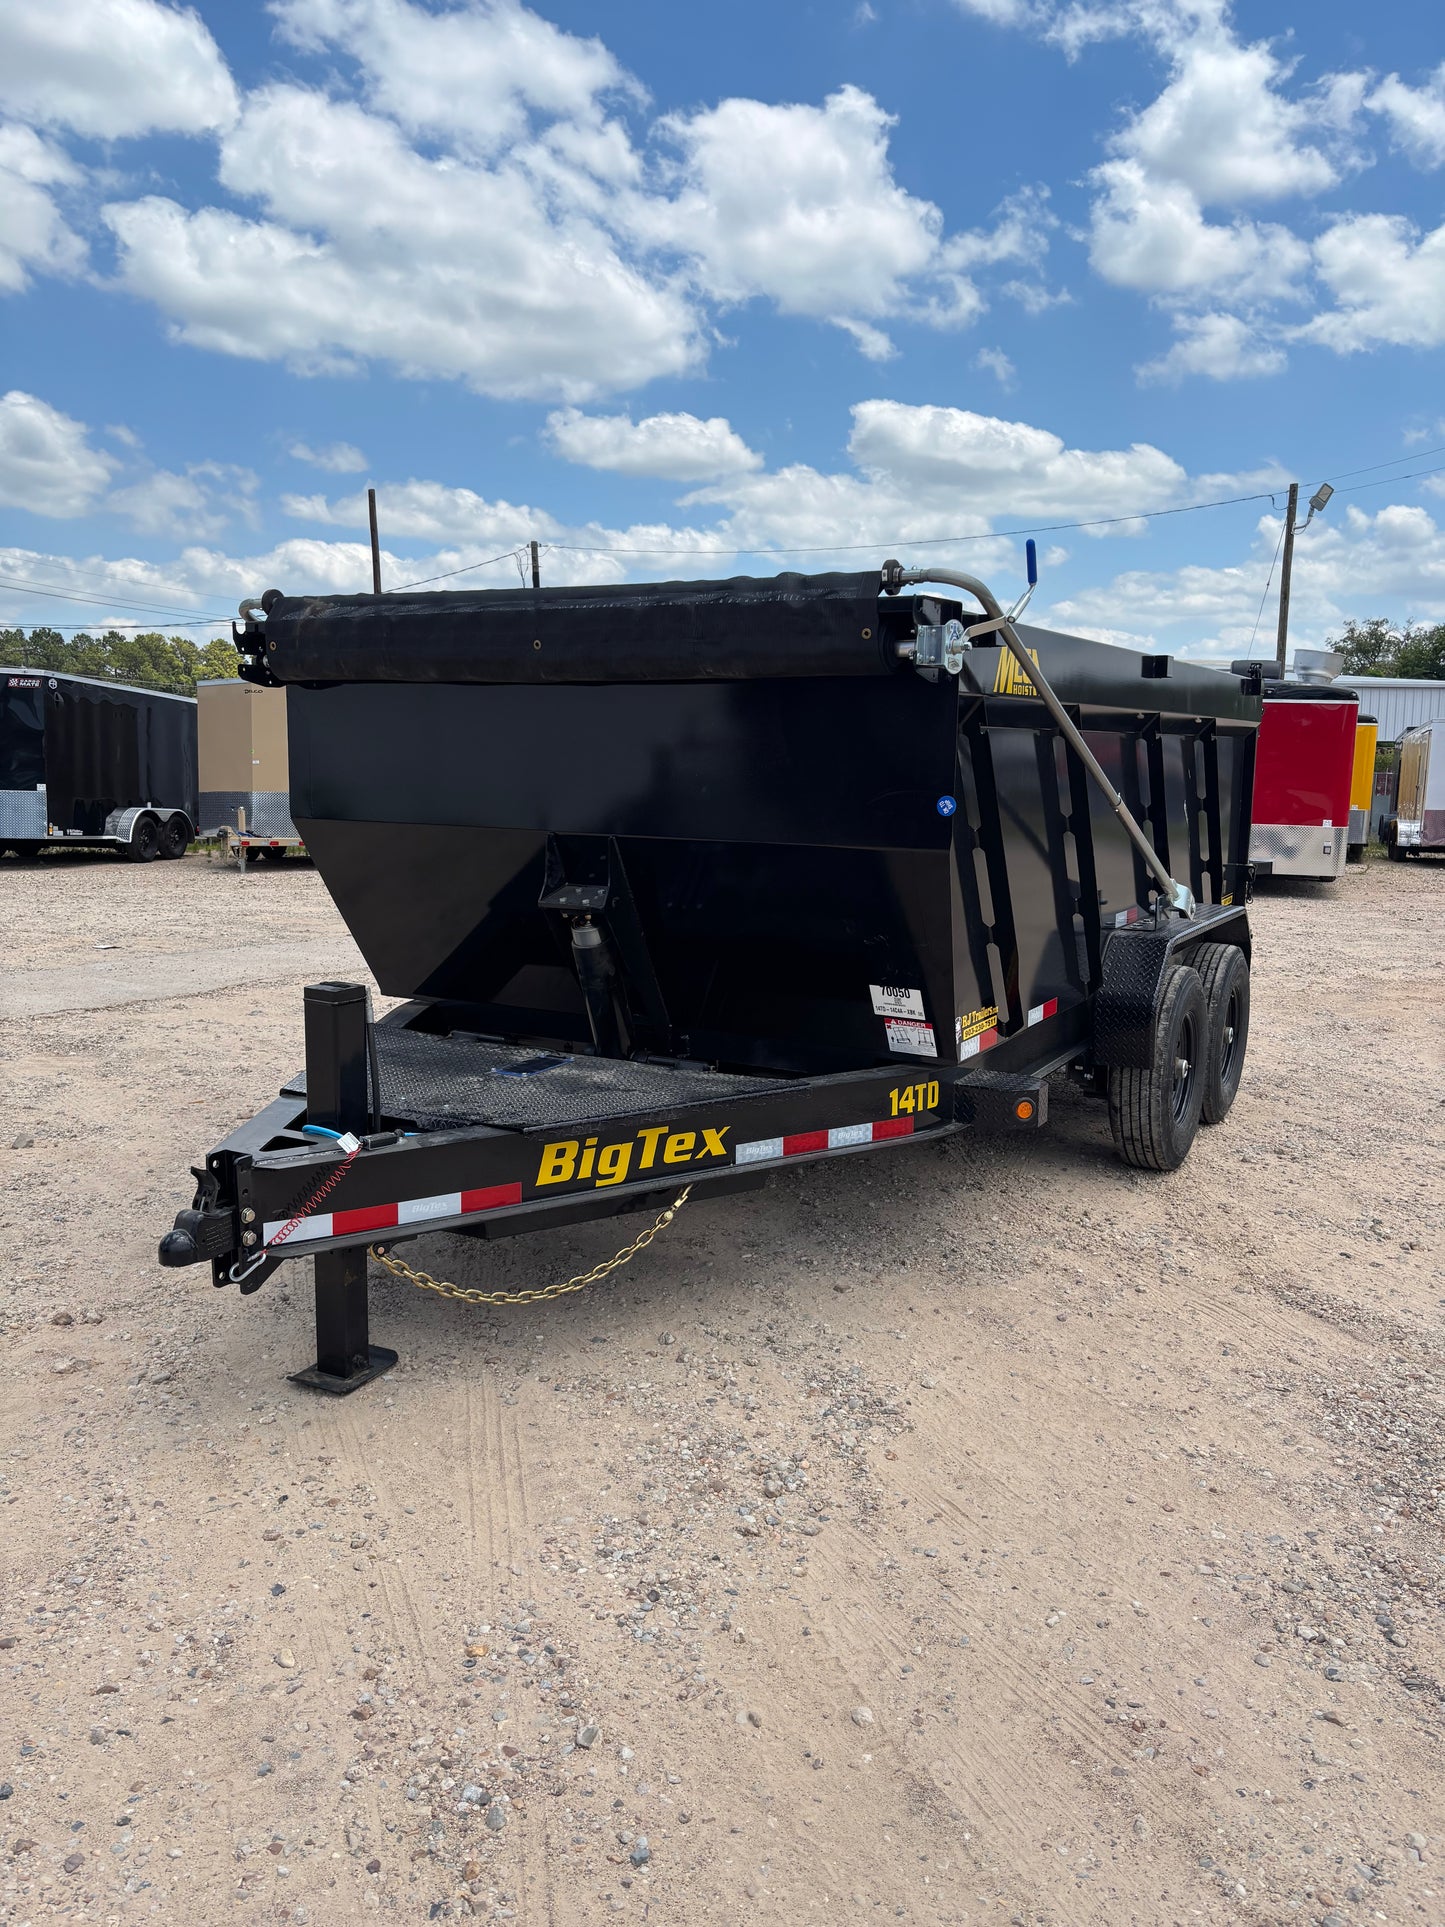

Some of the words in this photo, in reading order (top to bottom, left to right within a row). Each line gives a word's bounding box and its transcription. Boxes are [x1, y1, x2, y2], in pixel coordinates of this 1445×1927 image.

[1013, 684, 1033, 696] HOIST
[880, 986, 911, 999] 70050
[897, 1019, 926, 1029] DANGER
[889, 1080, 940, 1116] 14TD
[535, 1125, 732, 1188] BigTex
